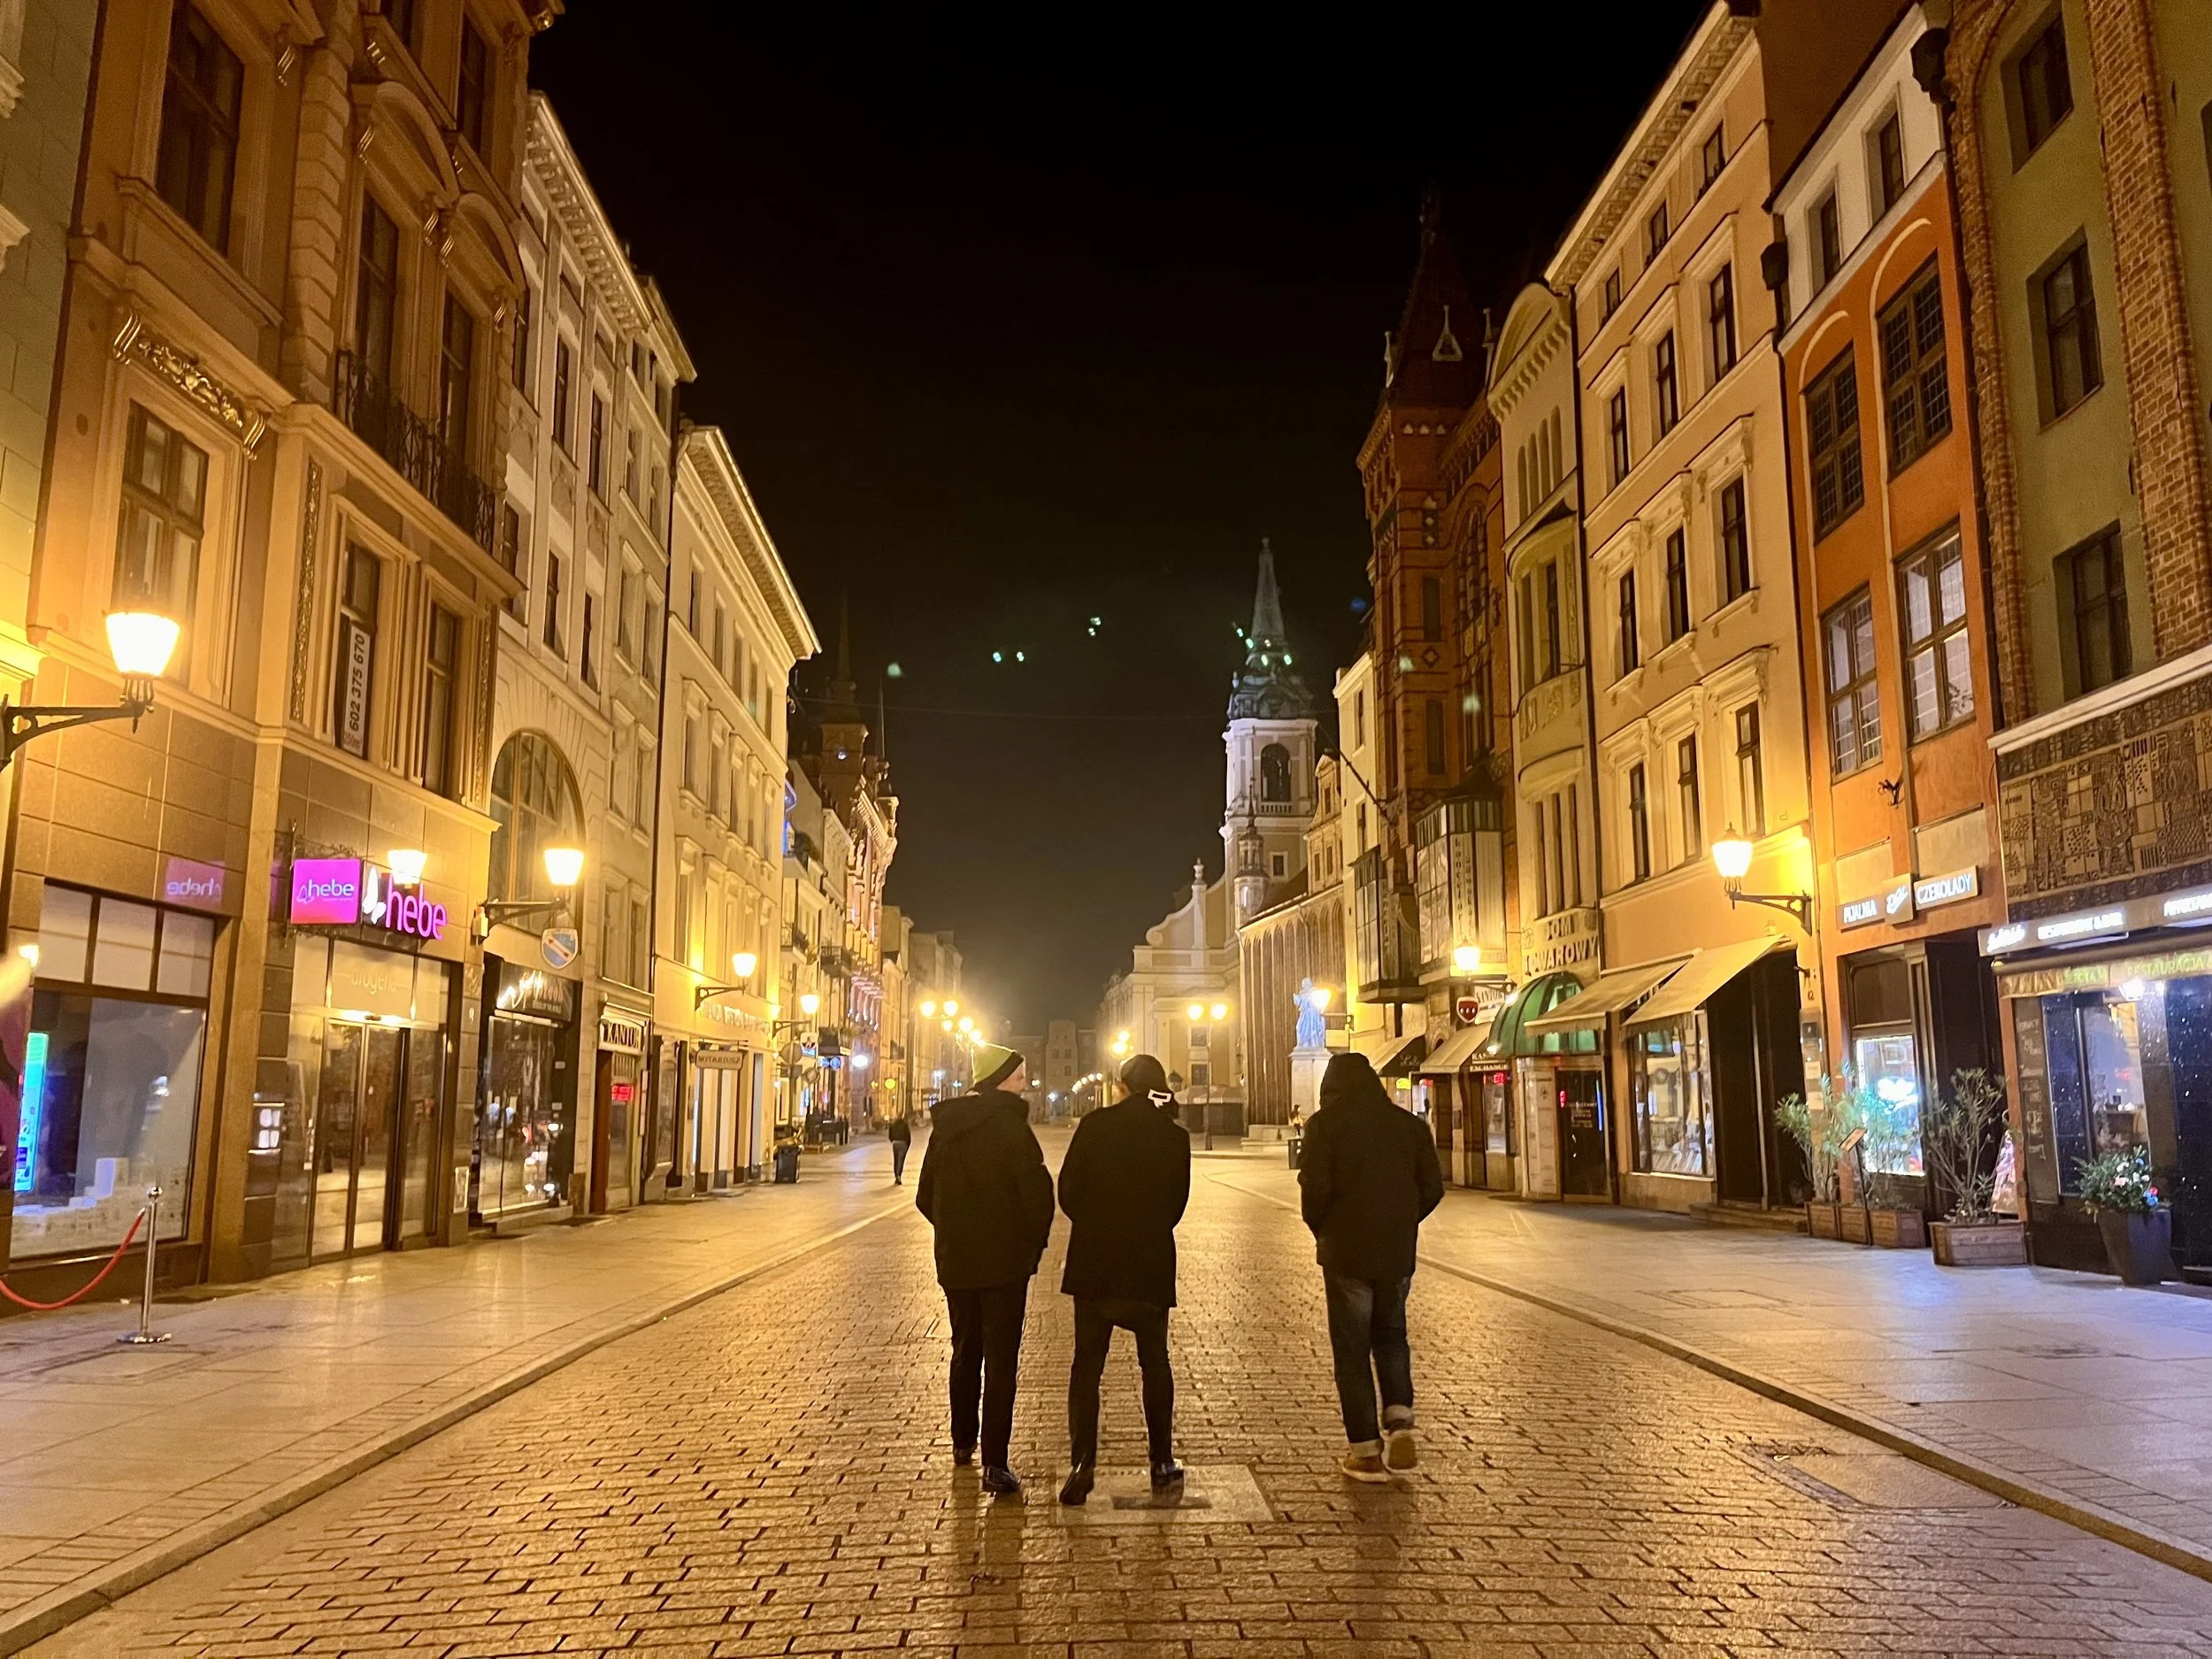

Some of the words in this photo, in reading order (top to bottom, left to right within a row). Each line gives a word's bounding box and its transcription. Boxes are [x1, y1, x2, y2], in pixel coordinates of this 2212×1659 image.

[354, 633, 365, 664] 670
[351, 666, 363, 698] 375
[349, 701, 361, 732] 602
[308, 878, 356, 897] hebe
[1916, 872, 1972, 904] CZEKOLADY
[385, 872, 449, 941] hebe
[1524, 935, 1598, 977] TOWAROWY
[697, 1055, 741, 1064] NOTARIUSZ
